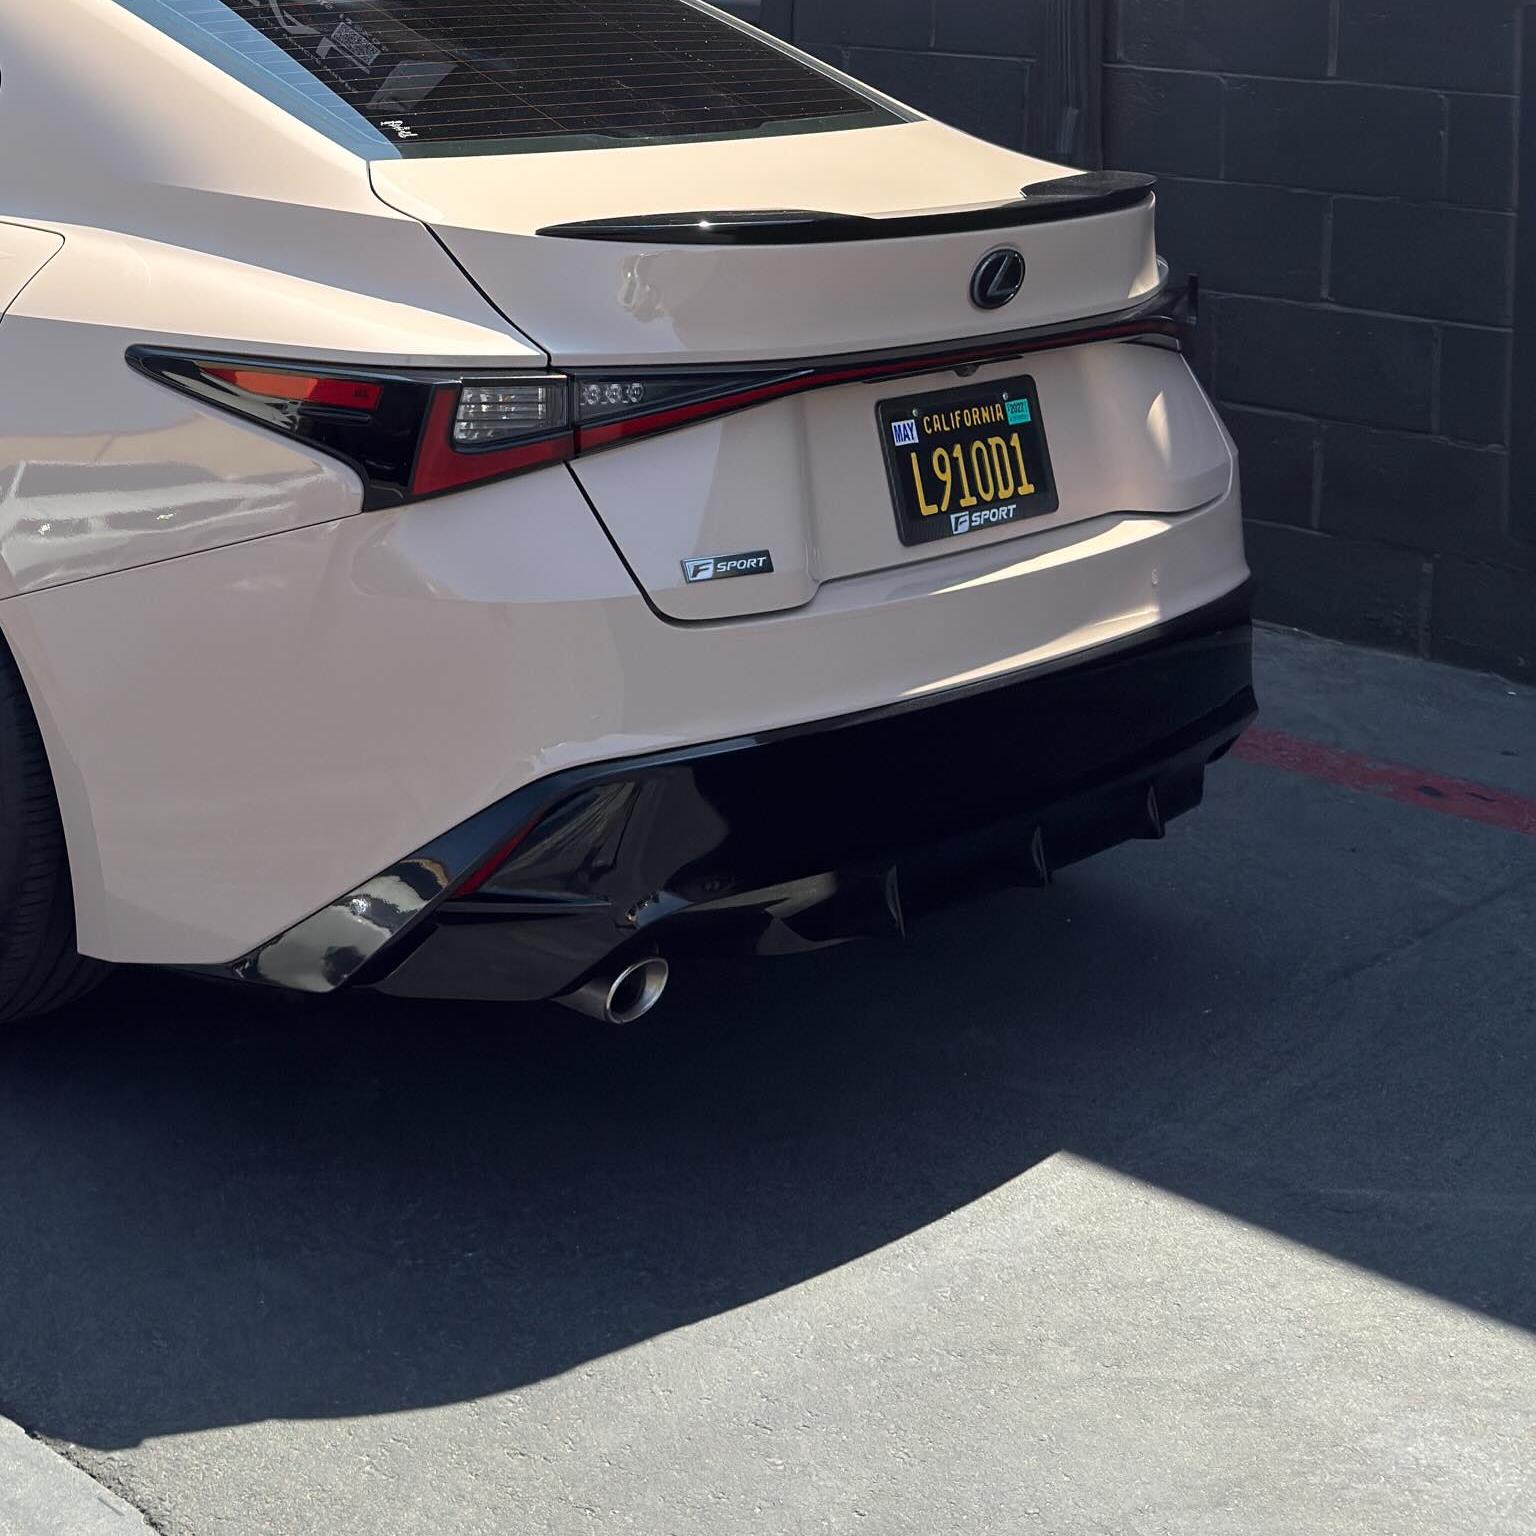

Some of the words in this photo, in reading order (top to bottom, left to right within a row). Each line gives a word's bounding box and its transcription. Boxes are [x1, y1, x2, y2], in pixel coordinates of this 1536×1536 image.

[922, 403, 1004, 434] CALIFORNIA
[893, 421, 917, 443] MAY
[910, 432, 1035, 516] L910D1
[971, 504, 1017, 526] SPORT
[716, 556, 767, 572] SPORT
